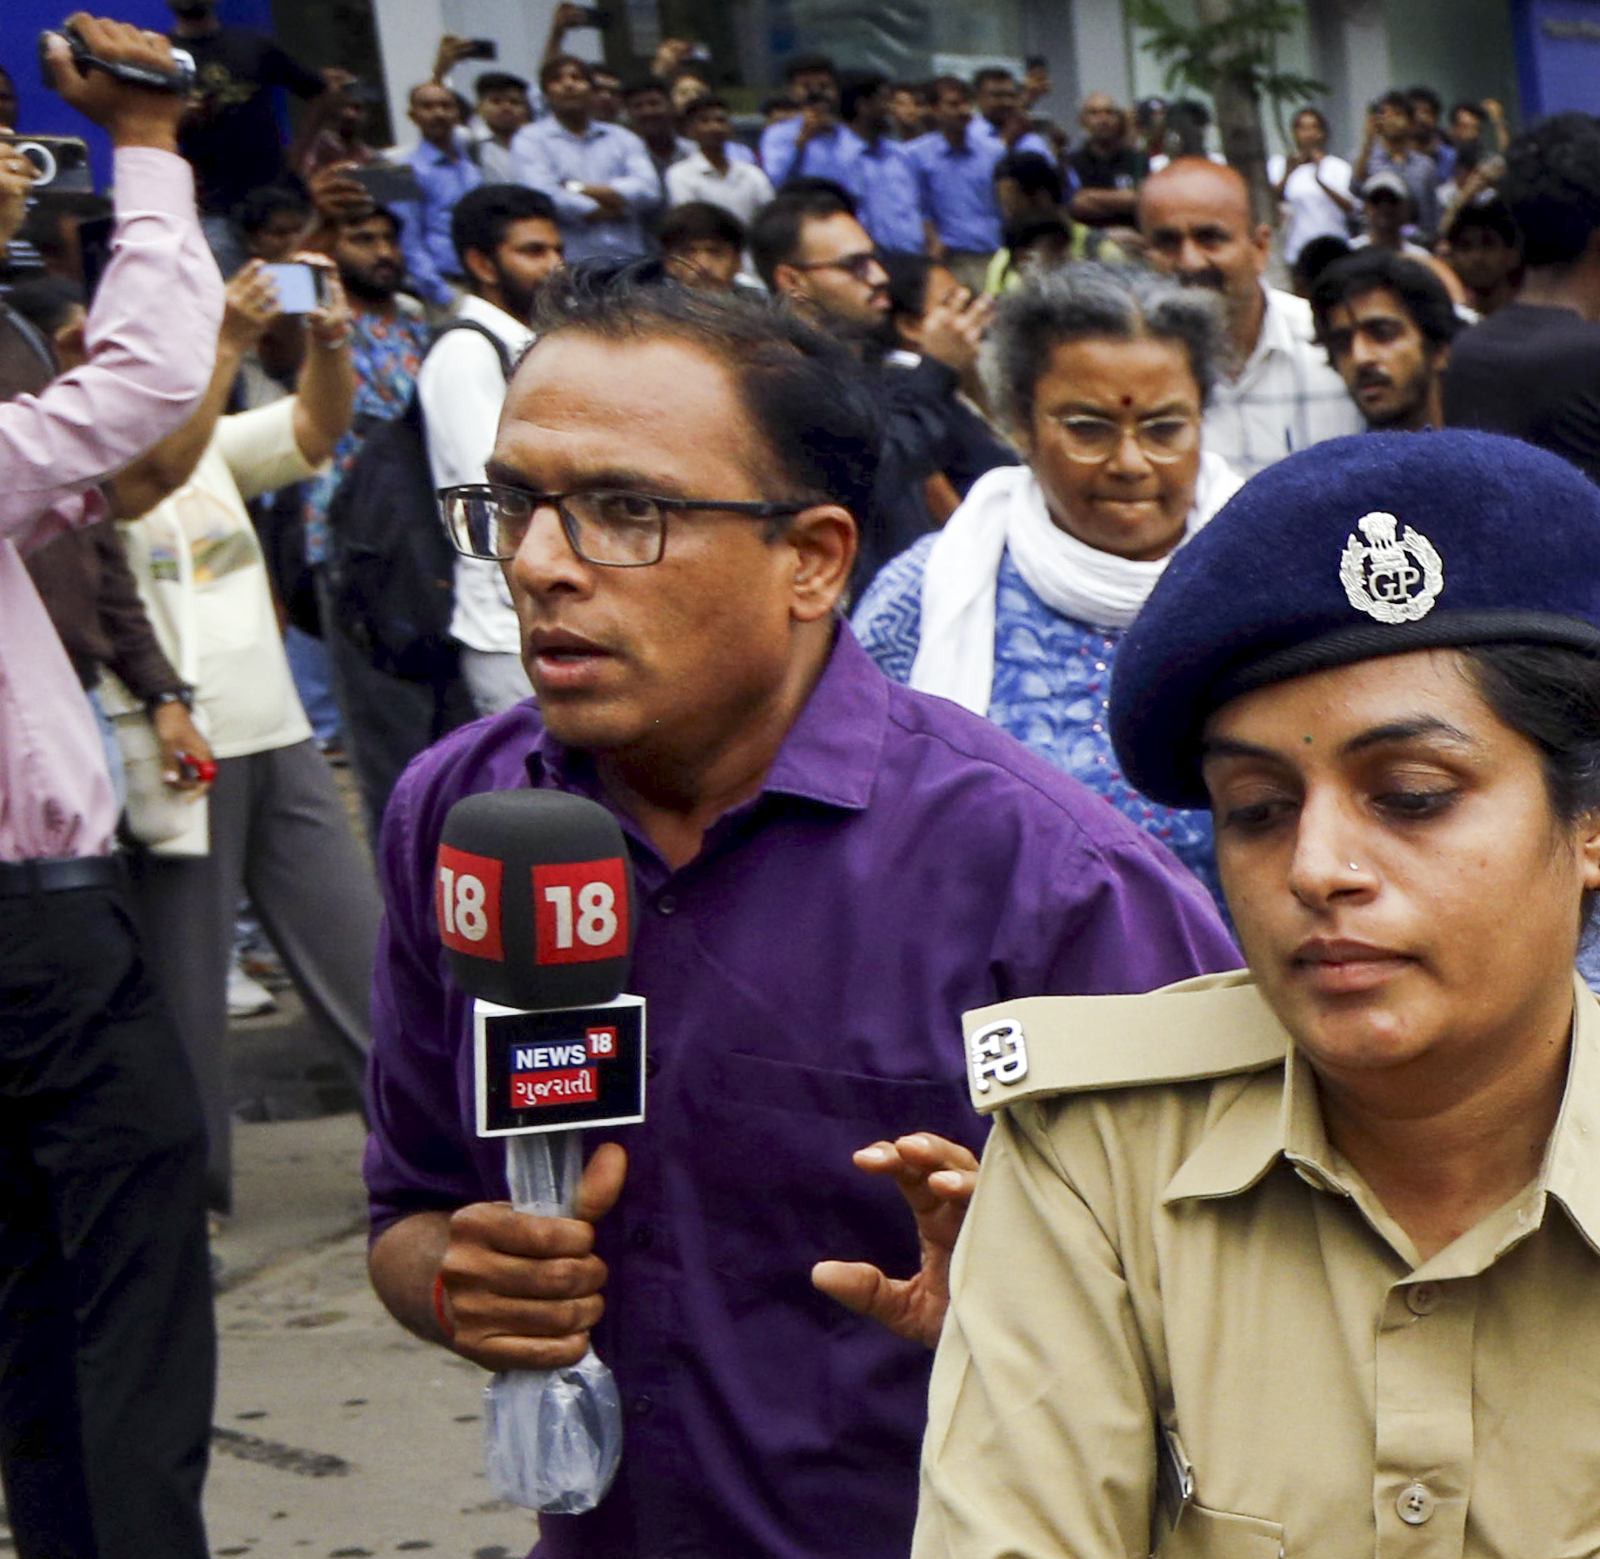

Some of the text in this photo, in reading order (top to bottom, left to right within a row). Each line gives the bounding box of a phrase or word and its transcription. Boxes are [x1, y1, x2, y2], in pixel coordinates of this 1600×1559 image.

[1369, 567, 1420, 600] GP
[439, 866, 488, 942] 18
[545, 881, 618, 948] 18
[516, 1033, 613, 1069] NEWS 18
[516, 1070, 592, 1105] ગુજરાતી
